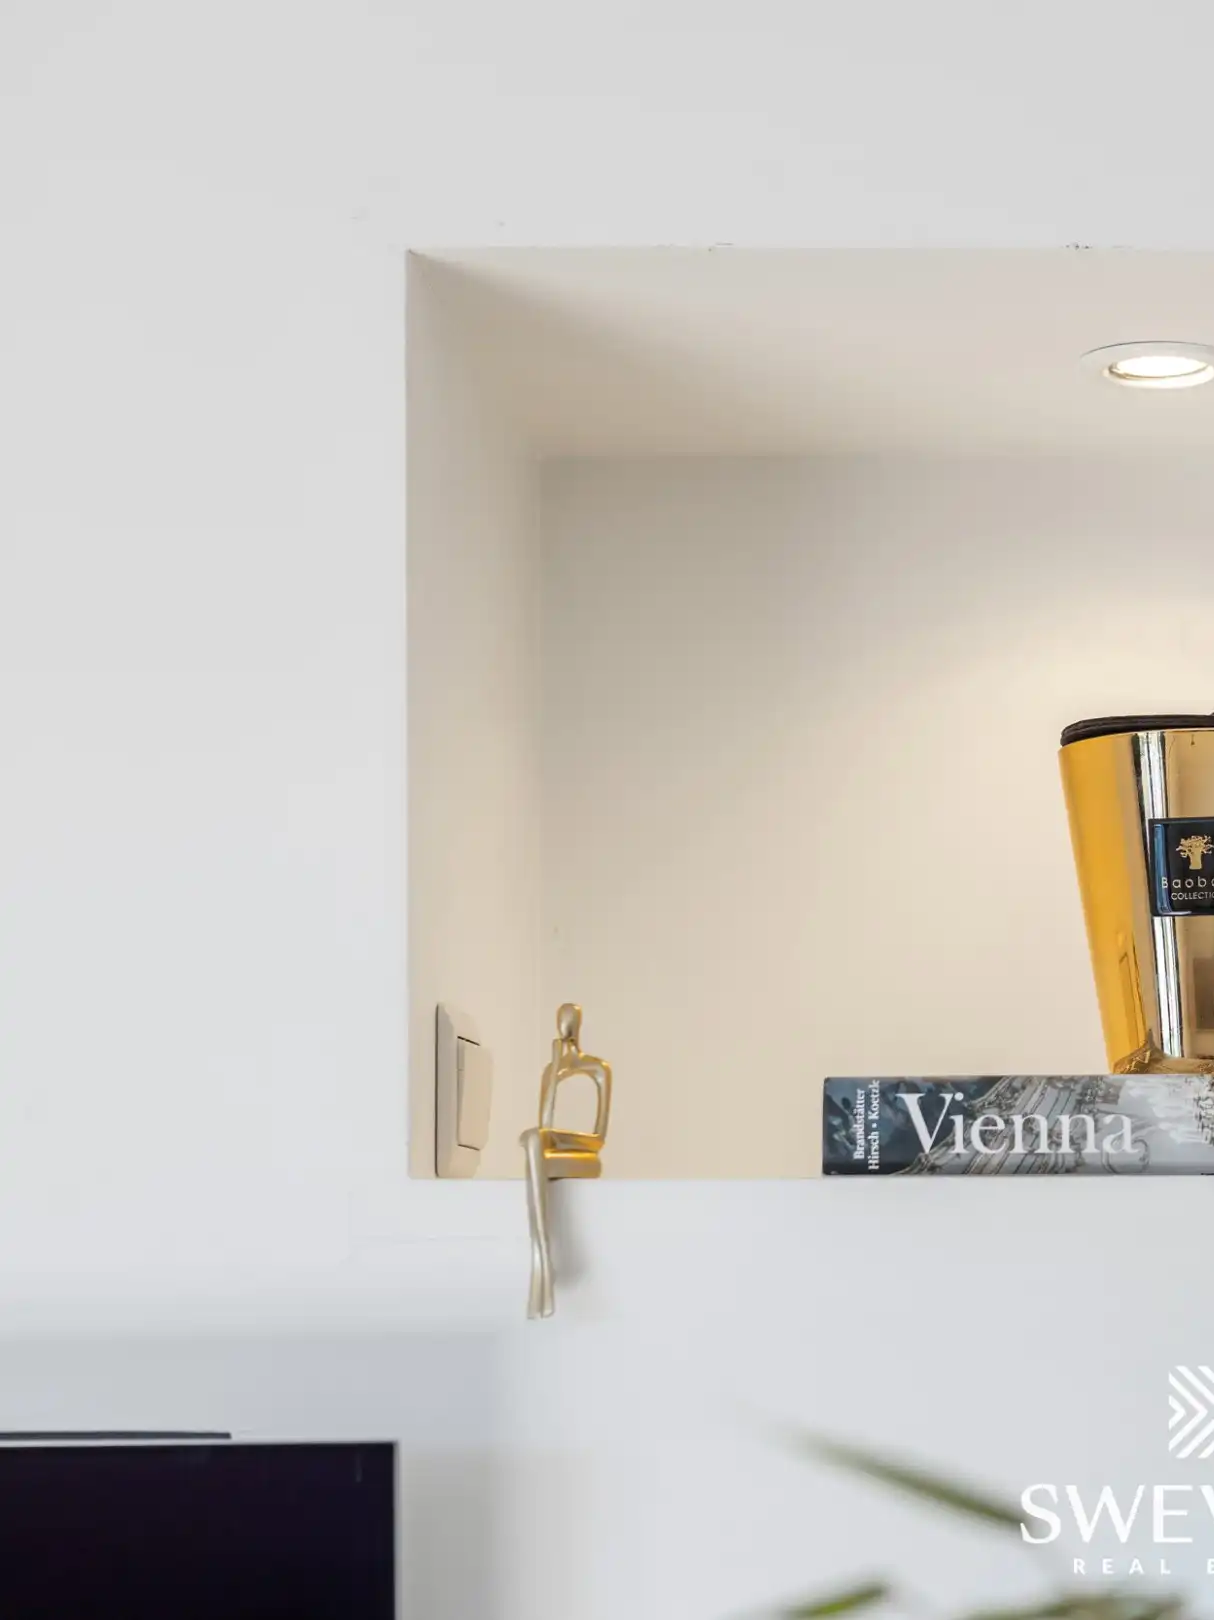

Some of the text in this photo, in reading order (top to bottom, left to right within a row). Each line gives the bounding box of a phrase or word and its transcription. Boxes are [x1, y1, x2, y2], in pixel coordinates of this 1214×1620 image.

[853, 1088, 865, 1159] Brandstätter
[867, 1131, 880, 1169] Hirsch
[895, 1092, 1139, 1155] Vienna
